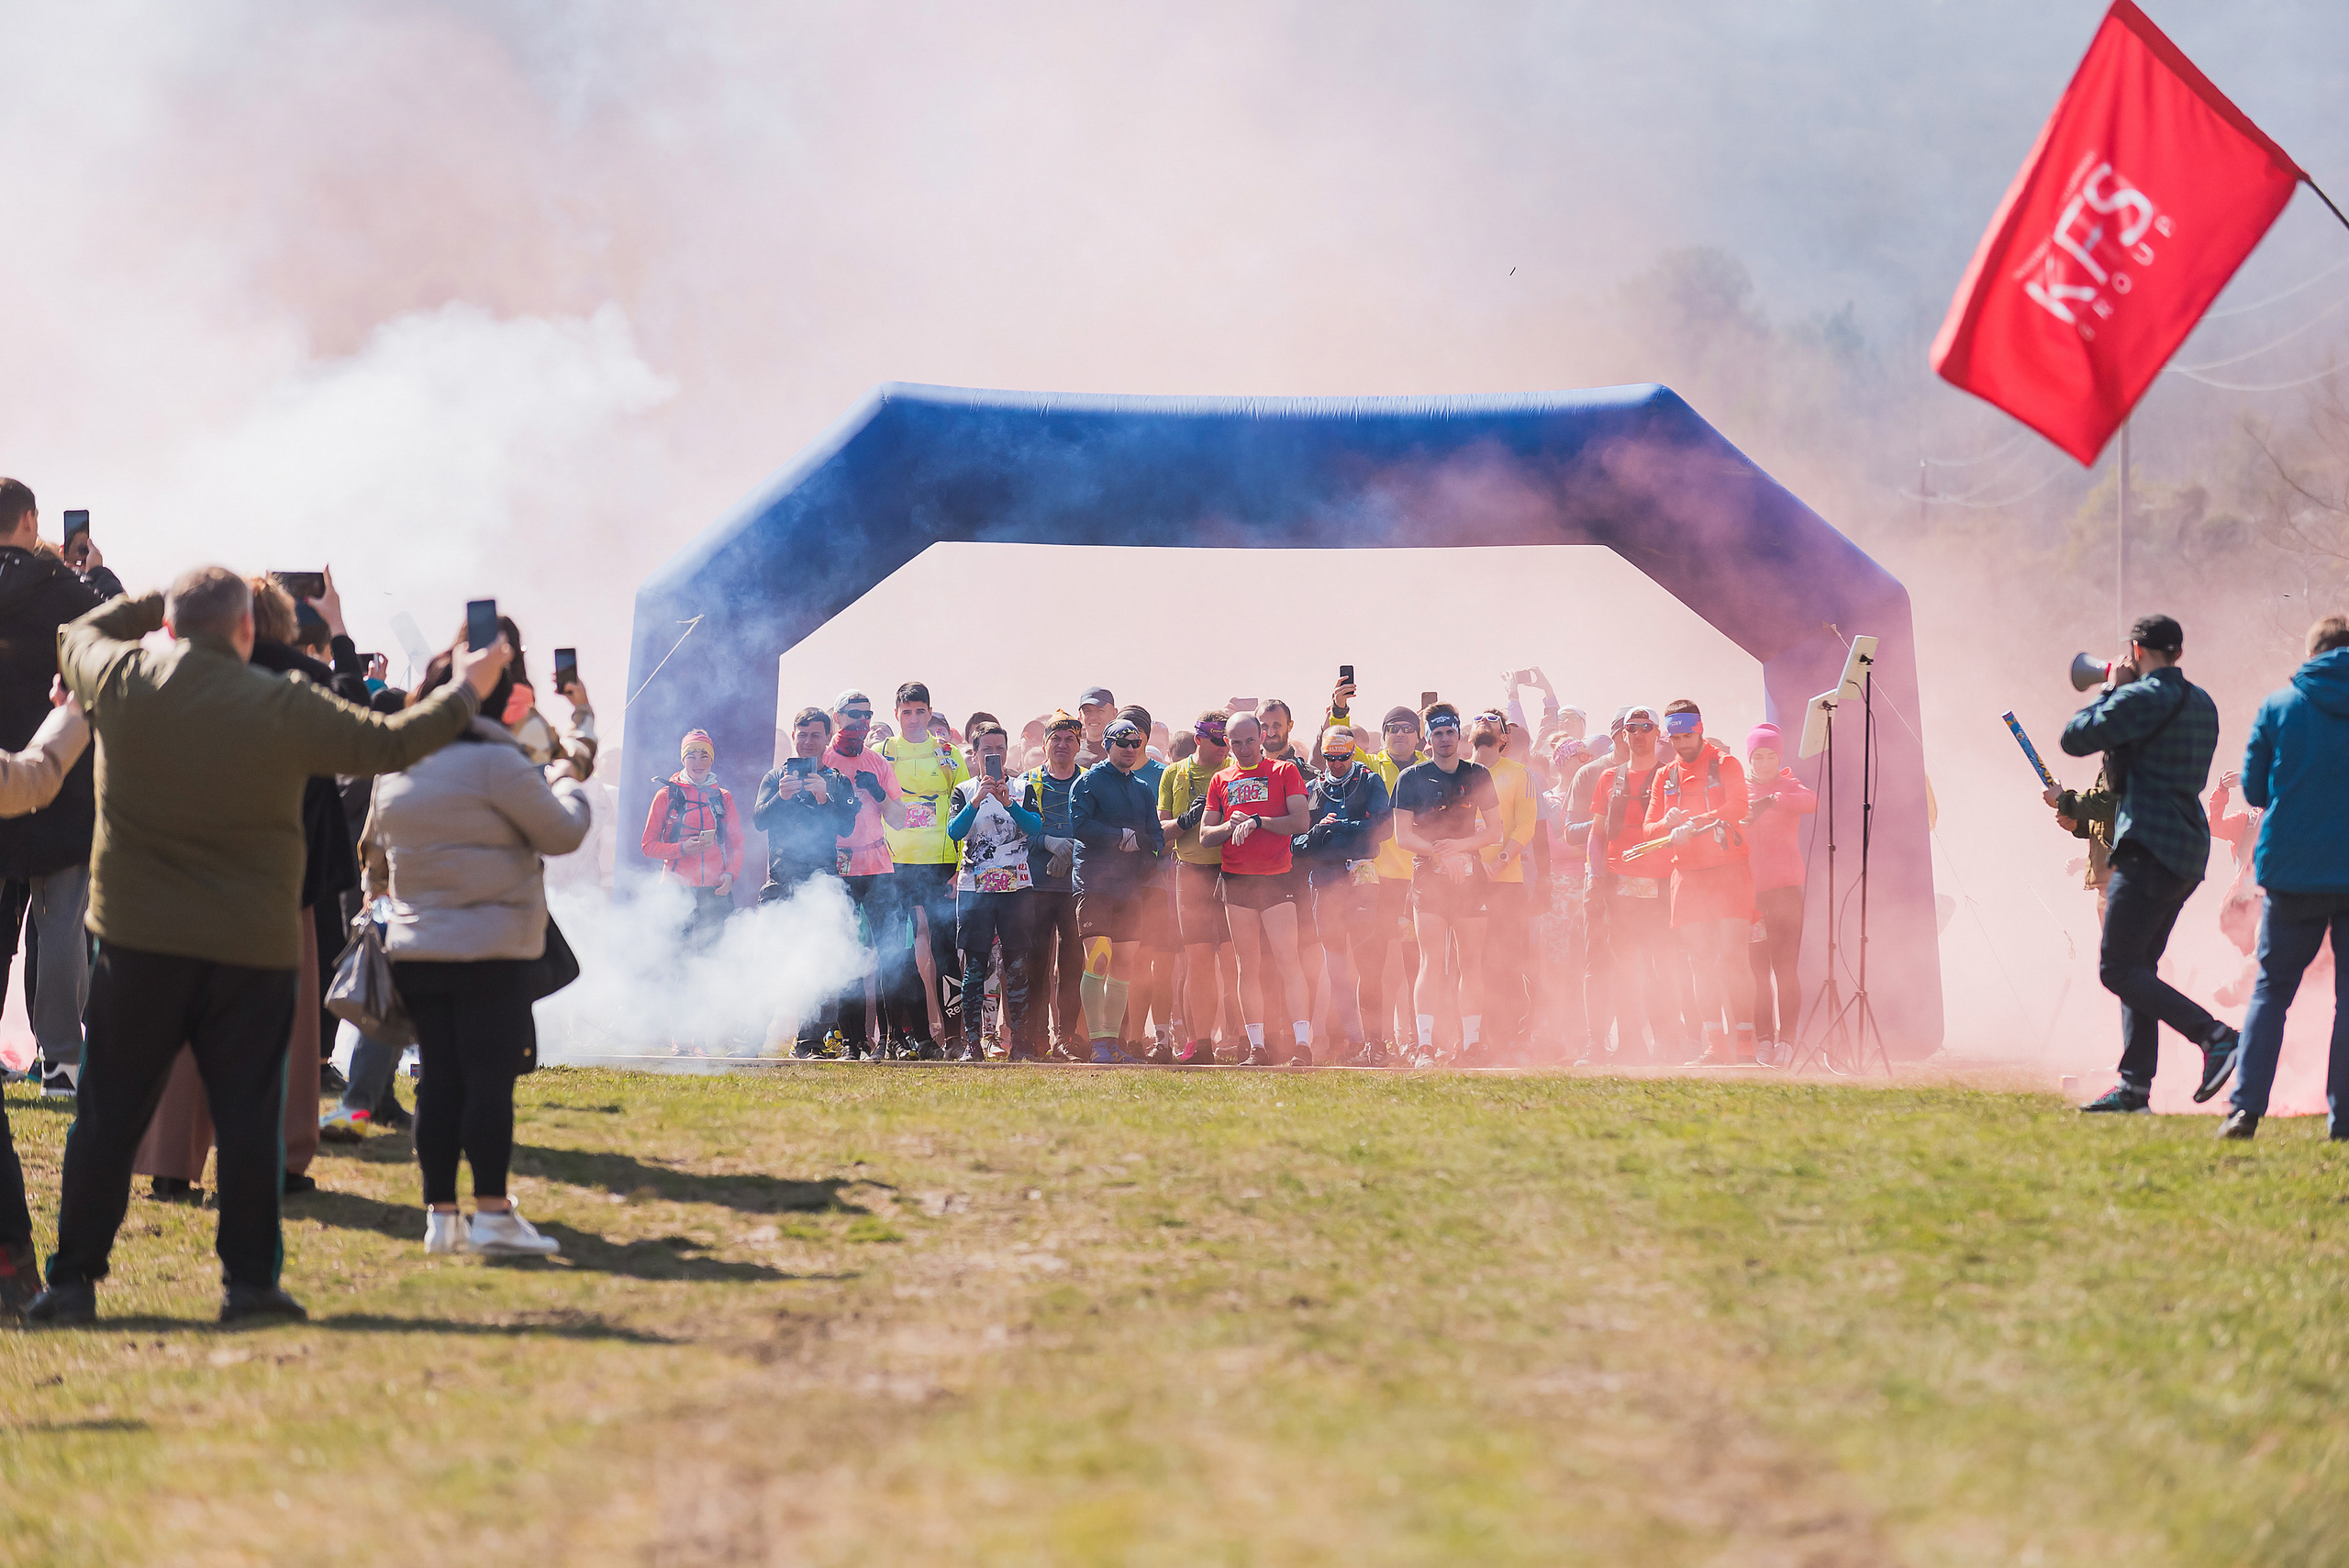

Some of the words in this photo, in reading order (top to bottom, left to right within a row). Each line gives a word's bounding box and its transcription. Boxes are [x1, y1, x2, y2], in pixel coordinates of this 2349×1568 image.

[2024, 162, 2154, 325] KFS
[1236, 784, 1259, 803] 105
[984, 873, 1008, 892] 258
